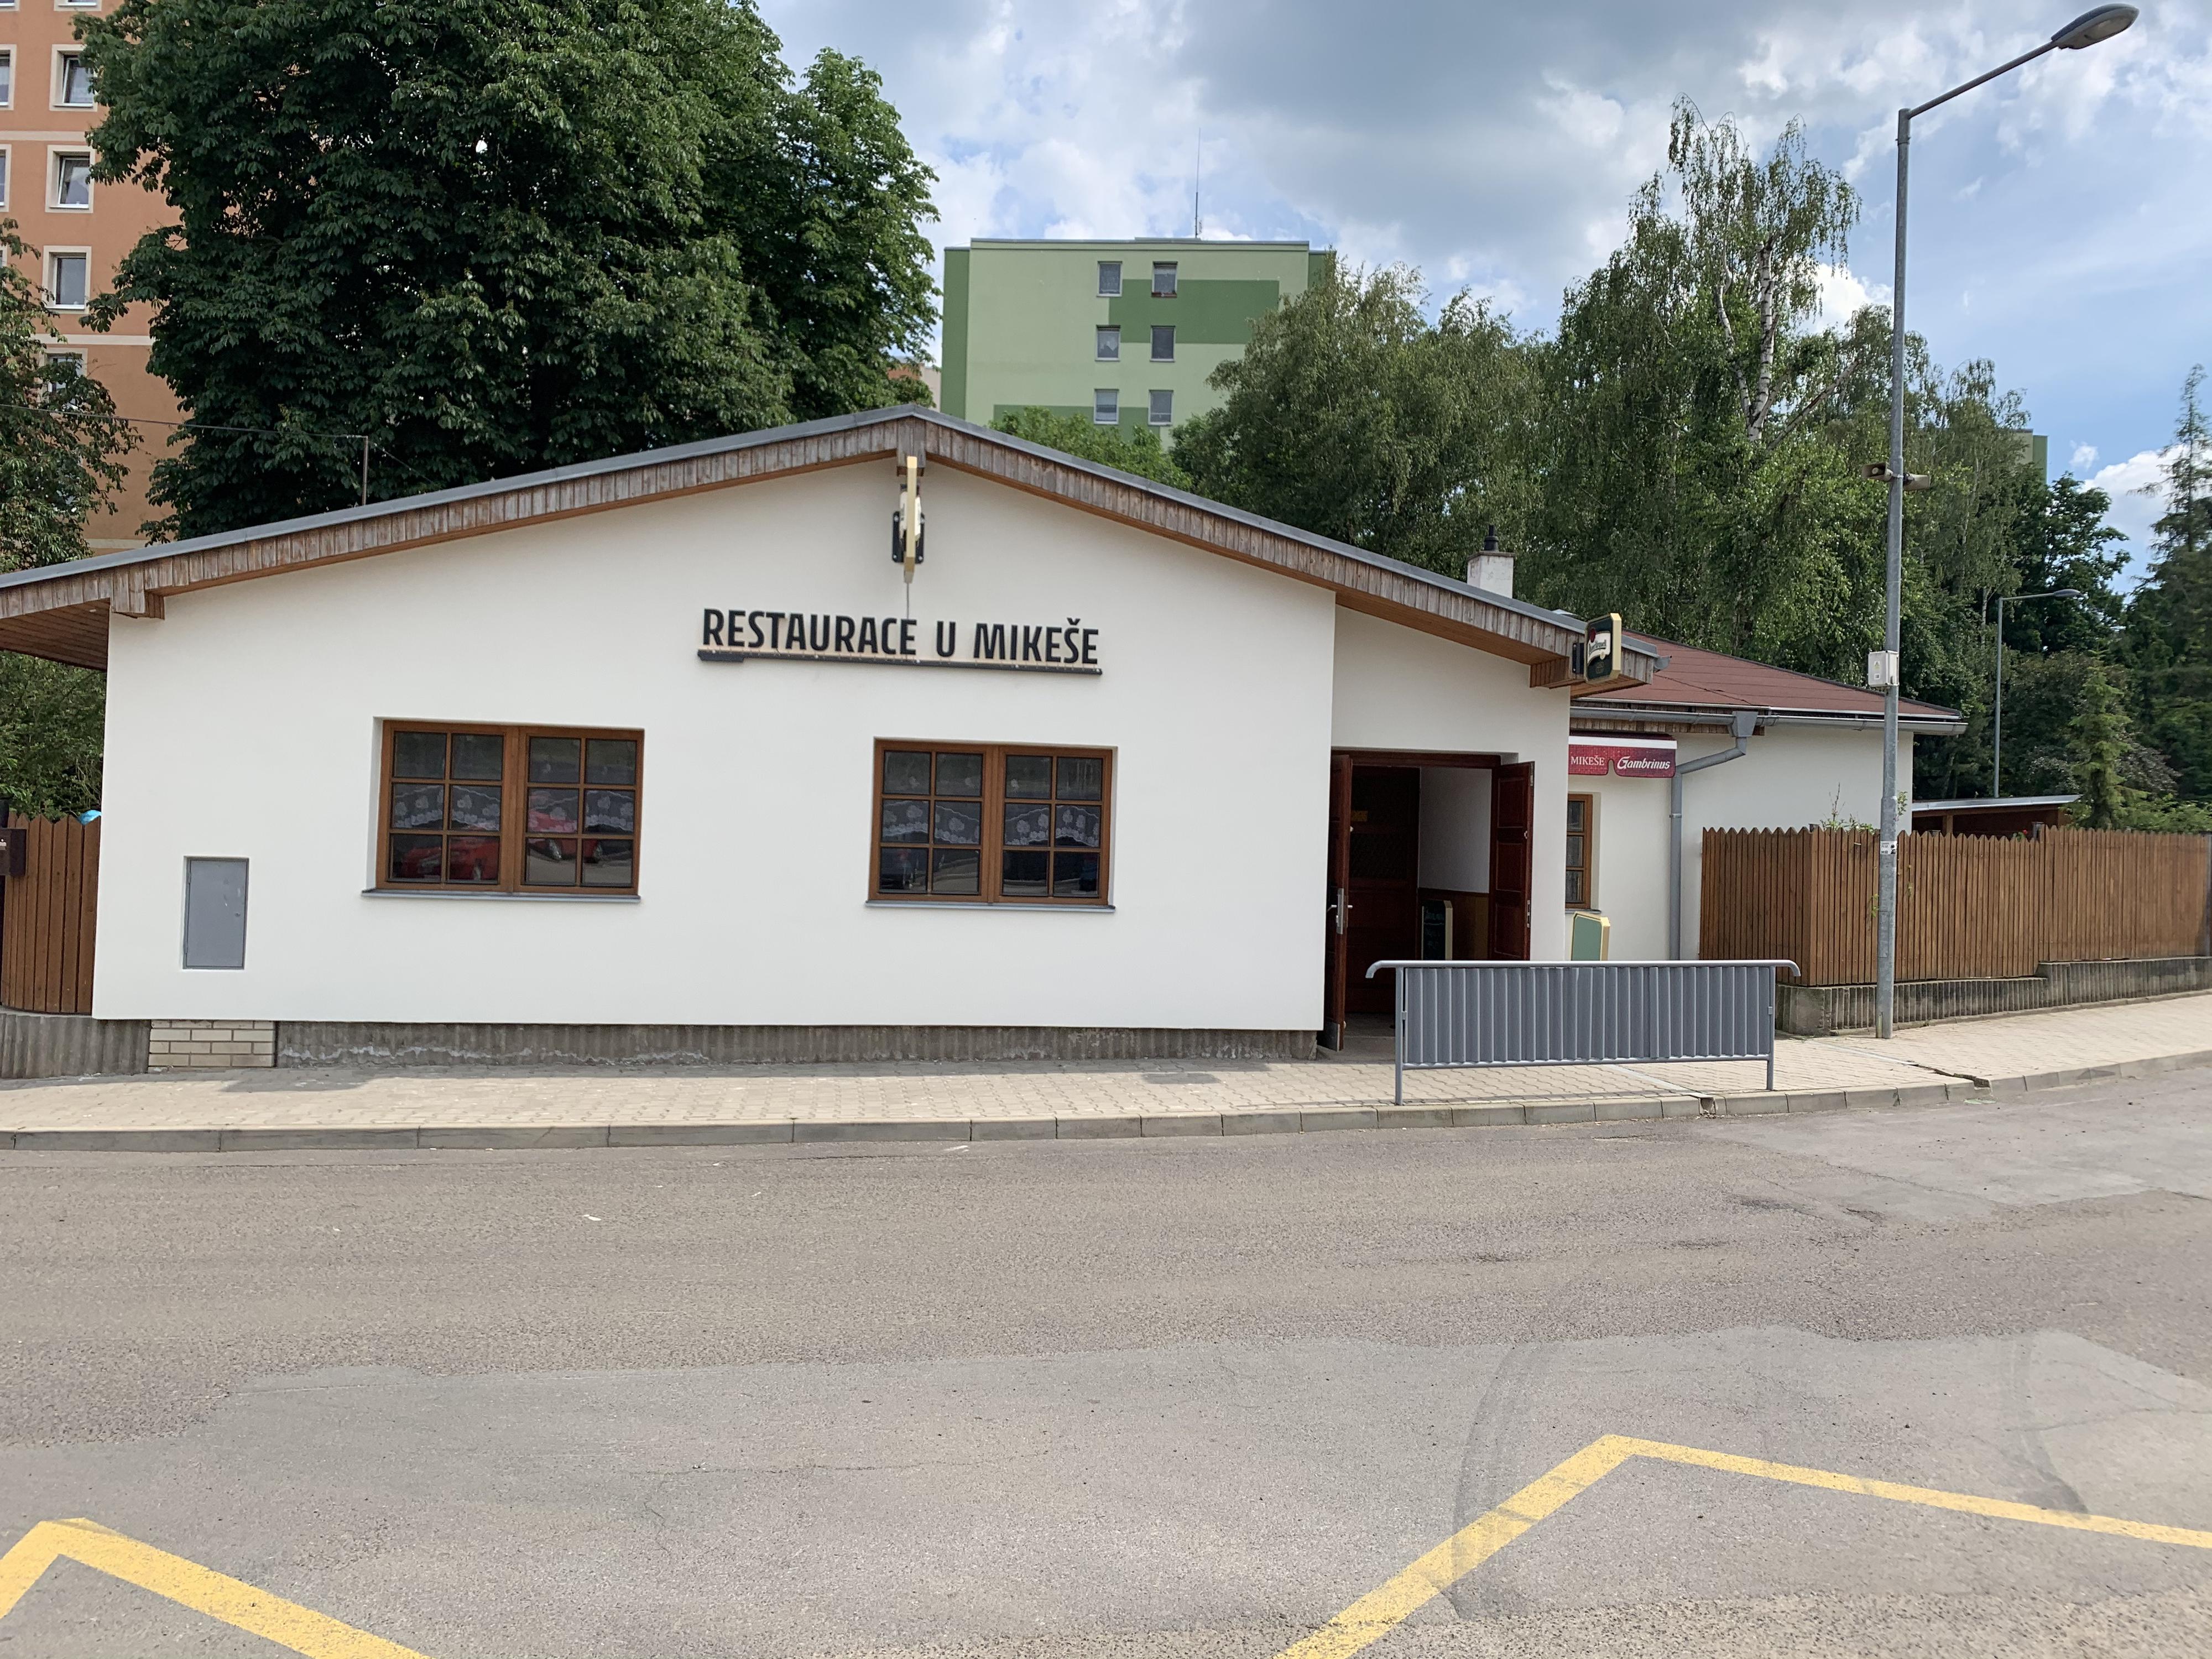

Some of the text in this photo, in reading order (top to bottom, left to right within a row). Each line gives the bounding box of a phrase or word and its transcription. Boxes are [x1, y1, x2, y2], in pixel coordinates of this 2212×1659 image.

[703, 608, 1099, 664] RESTAURACE U MIKEŠE
[1571, 755, 1605, 766] MIKEŠE
[1617, 756, 1671, 770] Gambrinus
